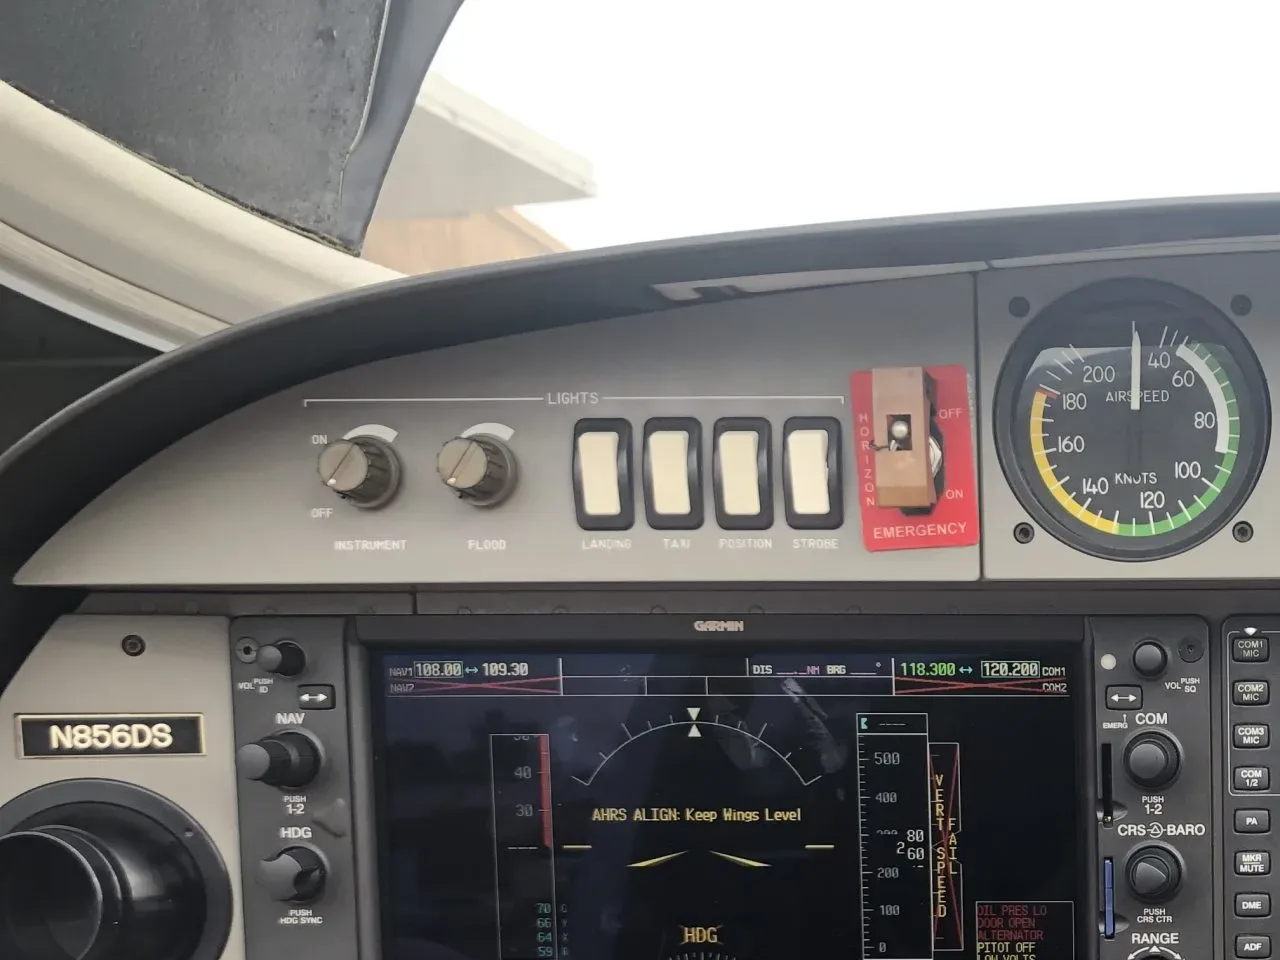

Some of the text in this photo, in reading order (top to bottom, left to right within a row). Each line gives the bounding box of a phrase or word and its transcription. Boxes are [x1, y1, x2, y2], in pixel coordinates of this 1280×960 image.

[1148, 353, 1171, 368] 40
[1083, 366, 1115, 383] 200
[1172, 371, 1195, 387] 60
[548, 392, 599, 404] LIGHTS
[1063, 394, 1086, 410] 180
[939, 408, 962, 419] OFF
[1194, 412, 1215, 429] 80
[1058, 436, 1085, 453] 160
[1175, 461, 1201, 478] 100
[1082, 478, 1108, 494] 140
[946, 490, 963, 499] ON
[1140, 492, 1165, 508] 120
[873, 523, 966, 539] EMERGENCY
[335, 540, 407, 550] INSTRUMENT
[468, 540, 506, 549] FLOOD
[582, 539, 631, 550] LANDING
[719, 539, 772, 549] POSITION
[793, 539, 838, 549] STROBE
[416, 662, 529, 677] 108.00 109.30
[901, 662, 1039, 676] 118.300 120.200
[276, 713, 305, 725] NAV
[1135, 713, 1168, 725] COM
[50, 724, 172, 749] N856DS
[592, 808, 801, 822] AHRS ALIGN: Keep Wings Level
[280, 827, 312, 839] HDG
[1118, 825, 1205, 835] CRS BARO
[1132, 934, 1179, 944] RANGE
[978, 942, 1035, 952] PITOT OFF
[1244, 943, 1262, 951] ADF
